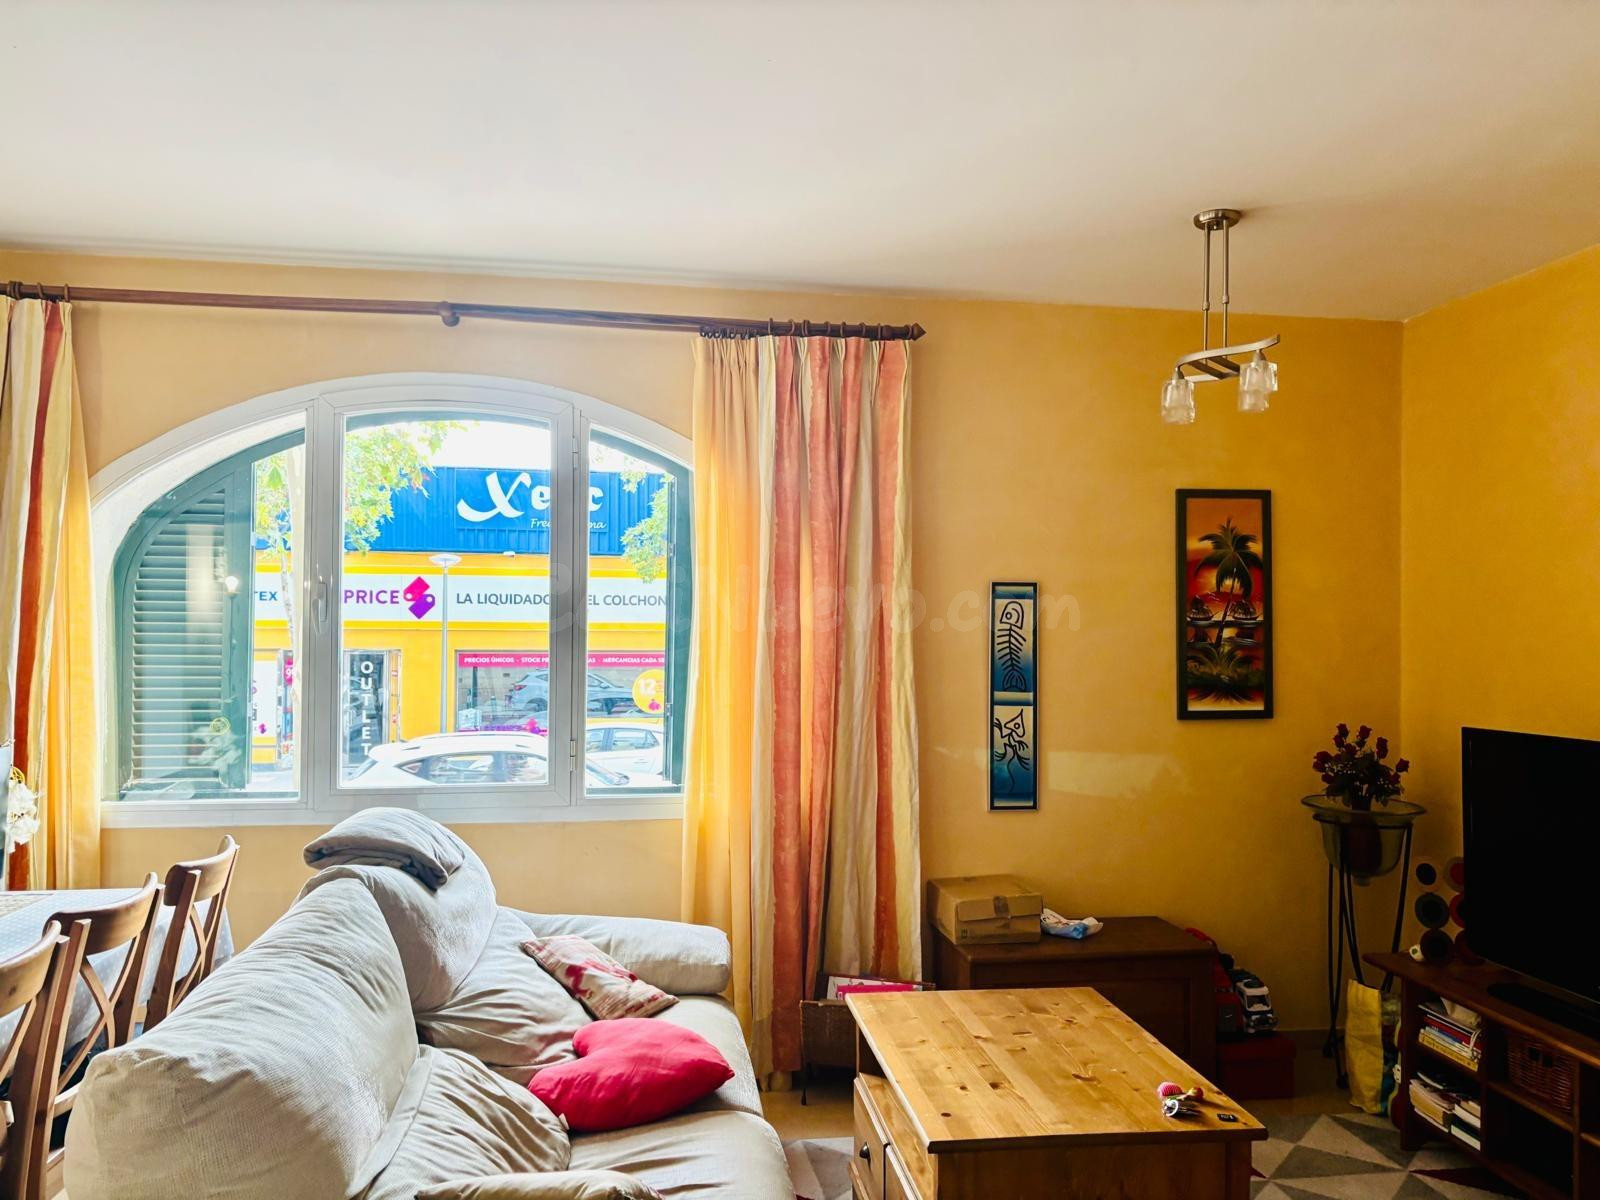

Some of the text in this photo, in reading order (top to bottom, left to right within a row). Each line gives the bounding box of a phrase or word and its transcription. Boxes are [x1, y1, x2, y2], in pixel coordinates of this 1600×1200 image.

[254, 591, 278, 601] EX
[343, 589, 400, 604] PRICE
[456, 593, 473, 604] LA
[477, 593, 550, 606] LIQUIDADO
[587, 594, 600, 606] EL
[360, 660, 375, 756] OUTLET
